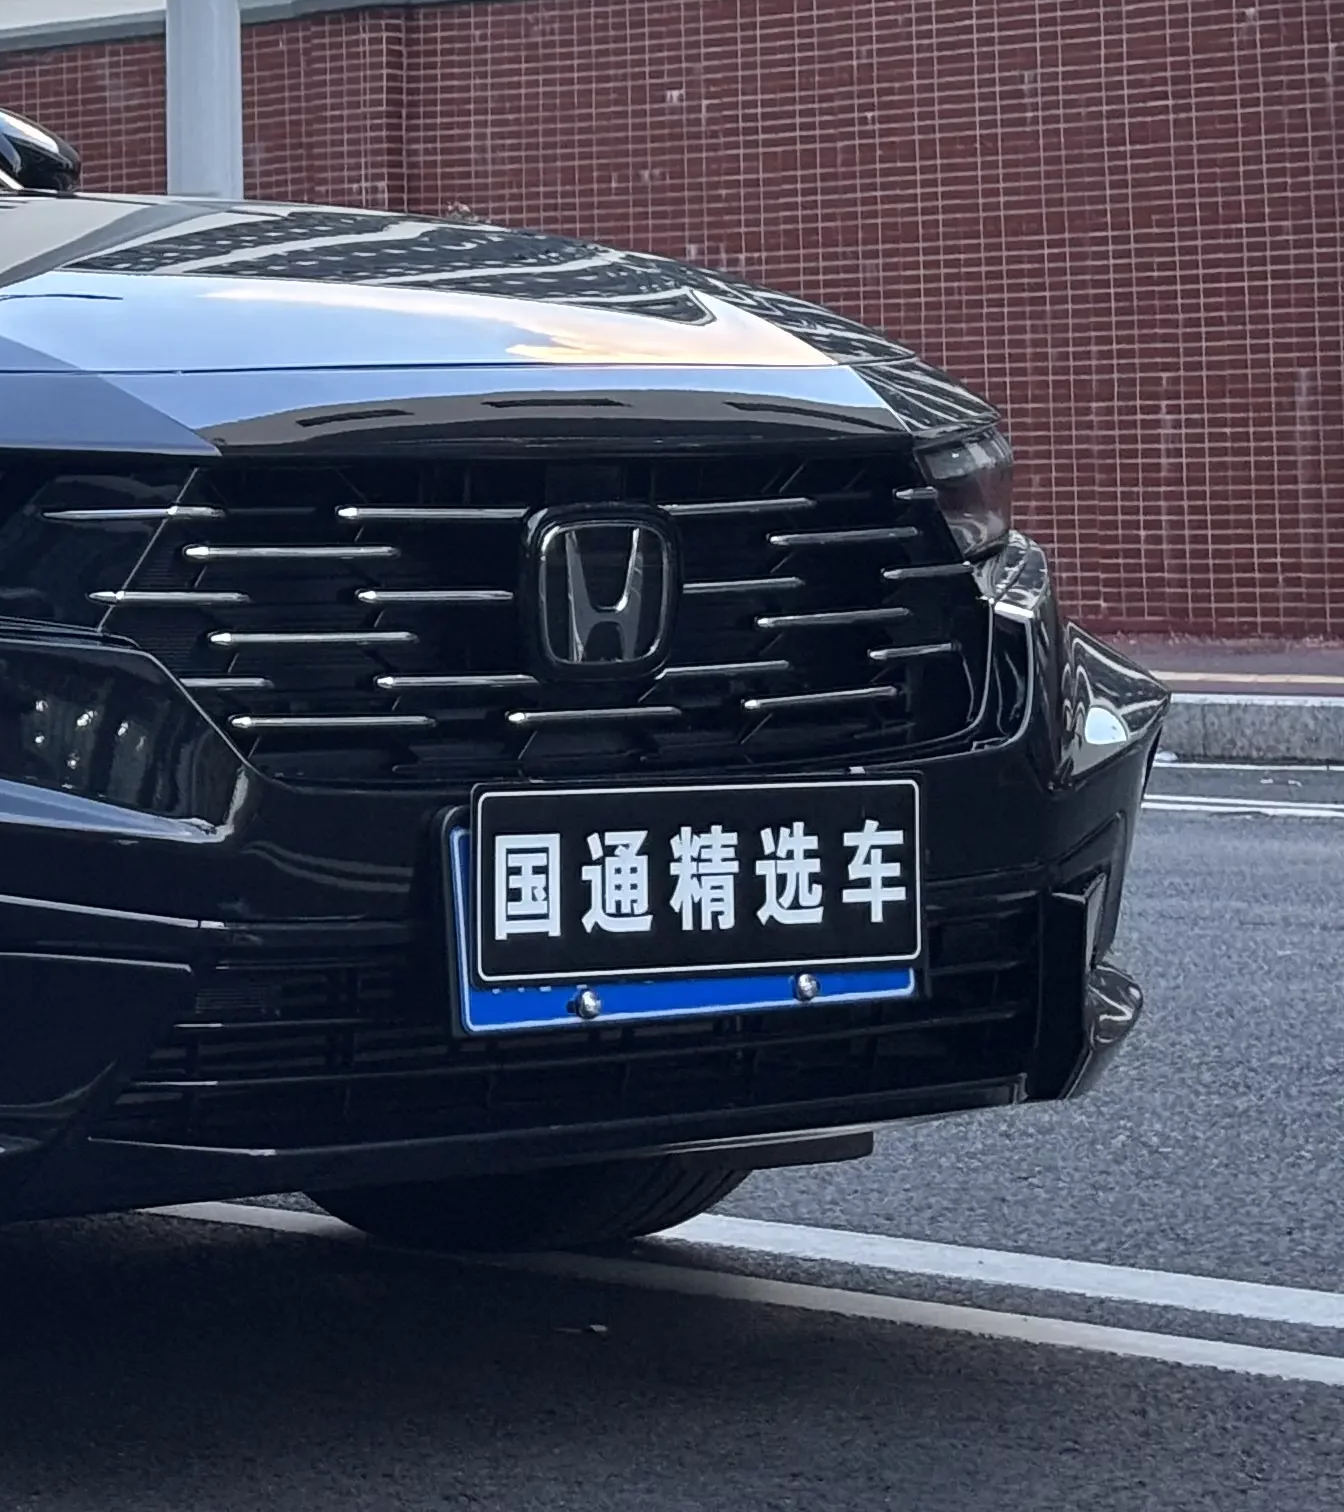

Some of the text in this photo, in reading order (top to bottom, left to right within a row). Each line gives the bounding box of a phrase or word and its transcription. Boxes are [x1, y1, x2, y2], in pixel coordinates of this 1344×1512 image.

[494, 820, 907, 941] 国通精选车
